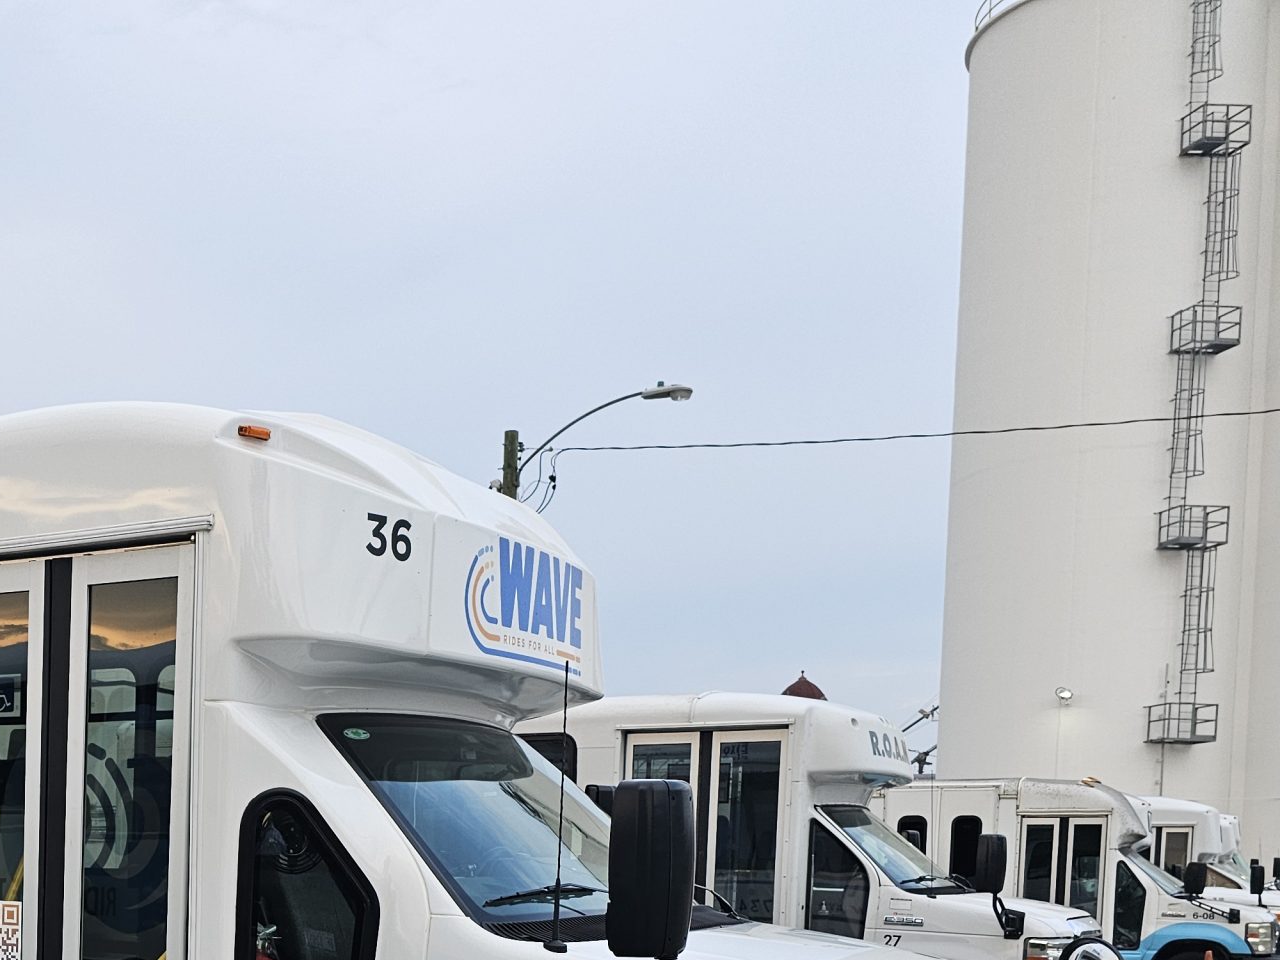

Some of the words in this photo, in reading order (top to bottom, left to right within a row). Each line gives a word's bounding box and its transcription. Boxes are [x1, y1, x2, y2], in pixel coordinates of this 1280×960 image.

[366, 512, 412, 562] 36
[499, 536, 583, 650] WAVE
[503, 634, 525, 648] RIDES
[528, 640, 541, 651] FOR
[544, 644, 555, 656] ALL
[1192, 912, 1215, 920] 6-08
[883, 934, 902, 947] 27
